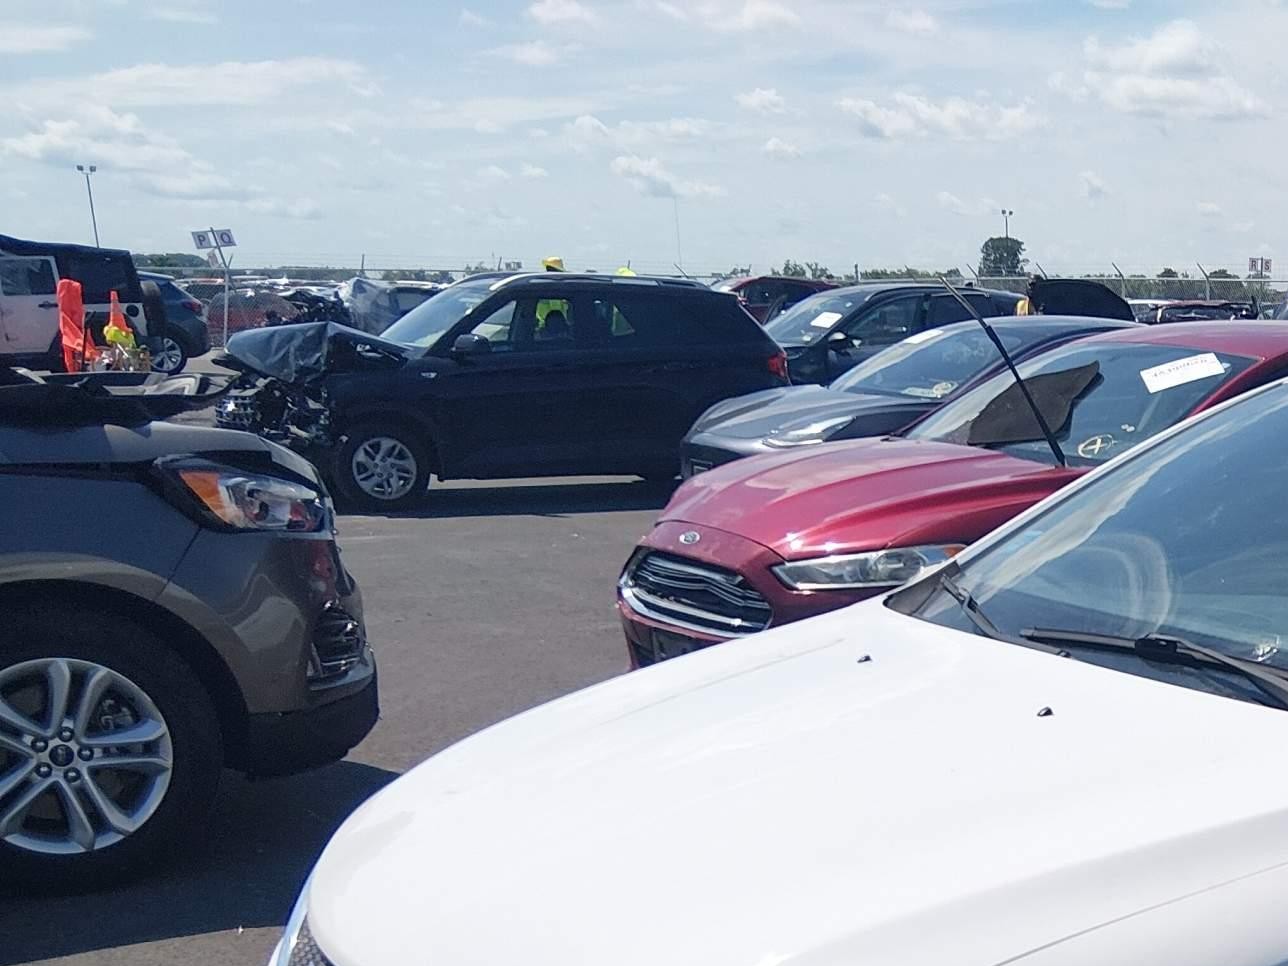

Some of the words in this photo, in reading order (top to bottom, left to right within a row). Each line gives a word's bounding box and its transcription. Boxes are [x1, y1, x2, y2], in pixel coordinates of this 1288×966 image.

[197, 234, 206, 246] P
[220, 232, 233, 244] Q
[1251, 260, 1257, 271] R
[1264, 261, 1270, 271] S
